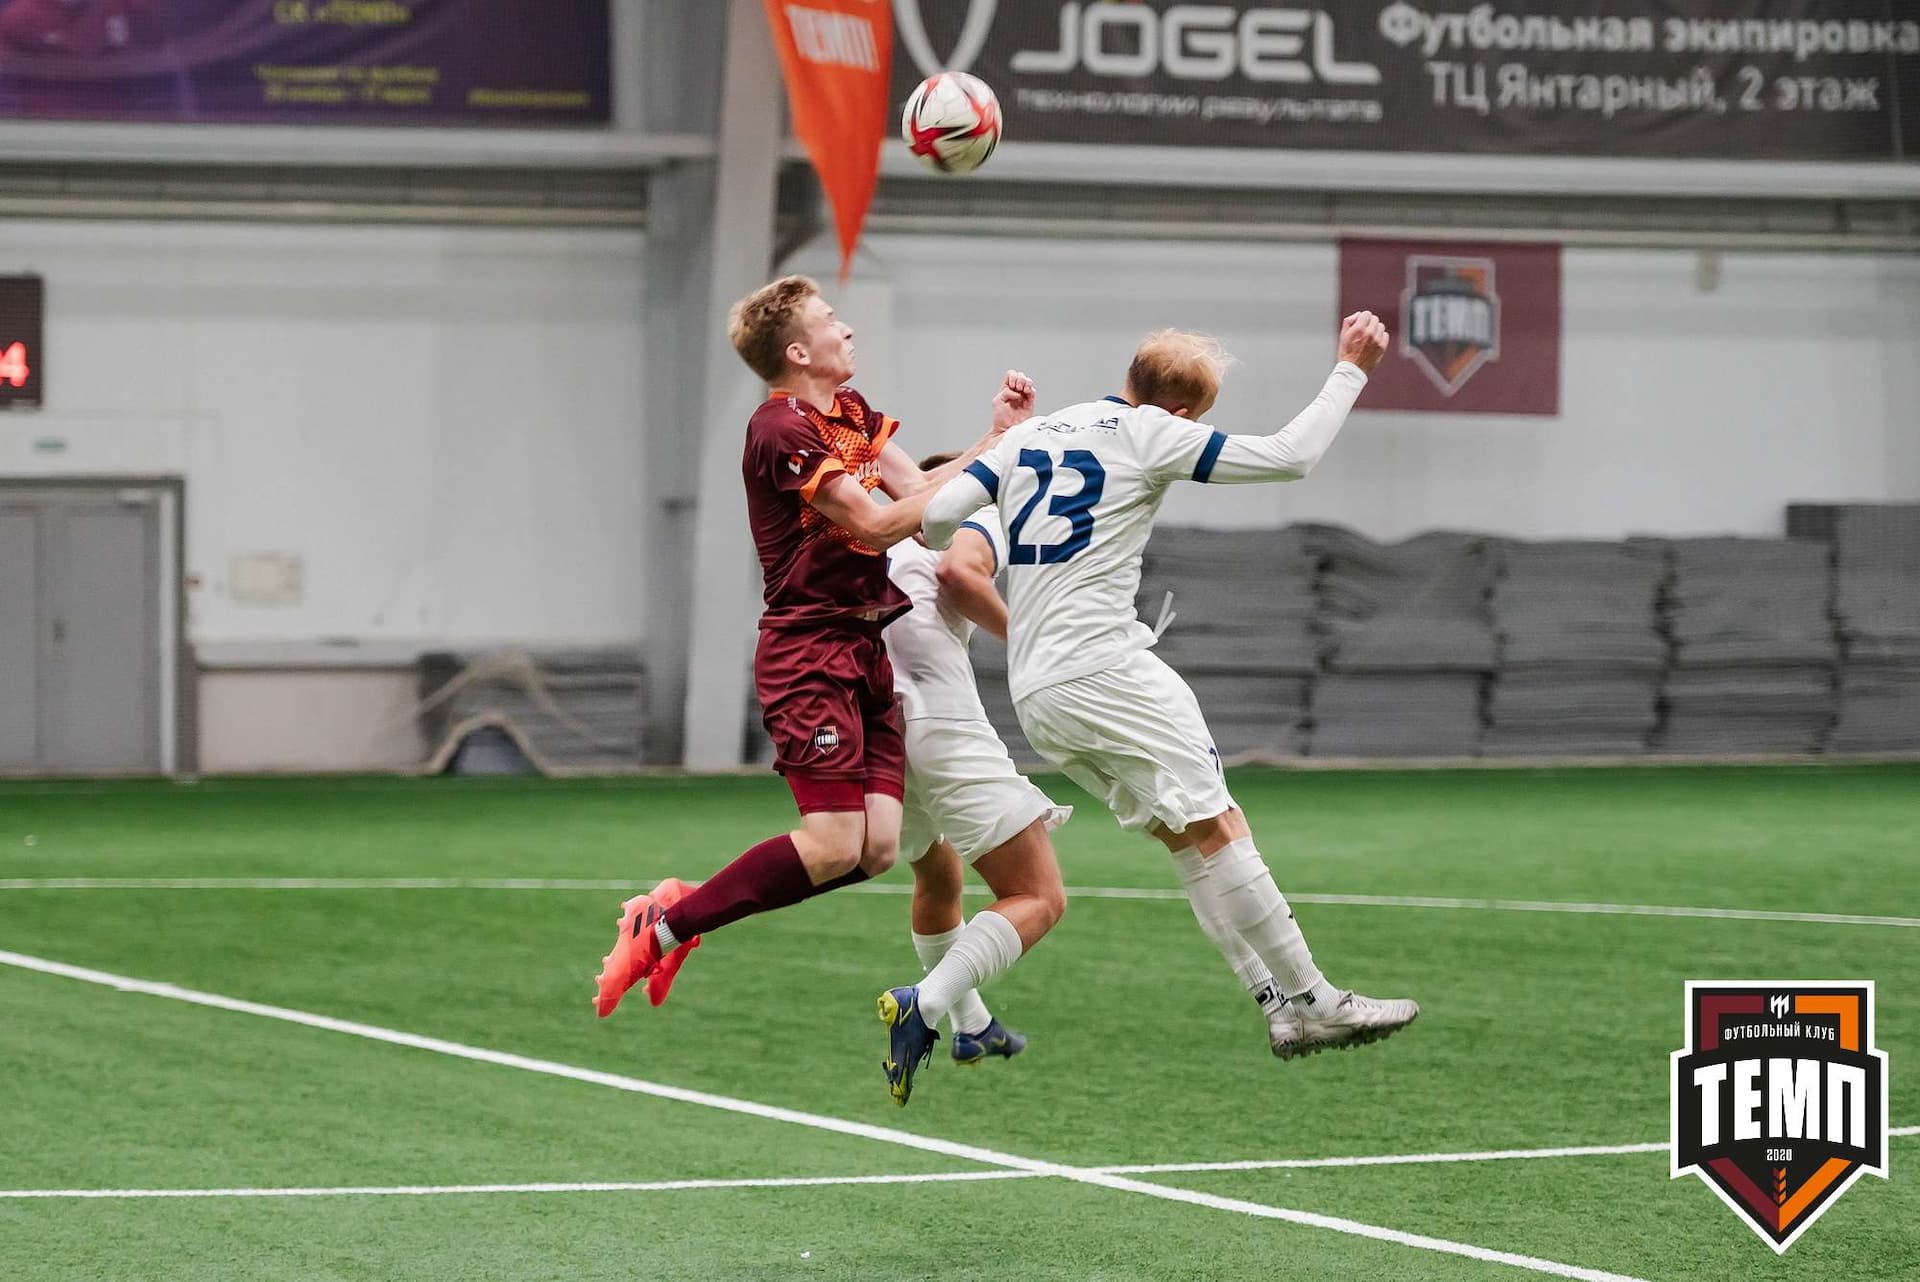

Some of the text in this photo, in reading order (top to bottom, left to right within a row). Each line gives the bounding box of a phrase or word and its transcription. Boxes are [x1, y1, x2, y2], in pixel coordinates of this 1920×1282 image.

[1379, 3, 1919, 62] Футбольная экипировка
[1424, 61, 1490, 116] ТЦ
[1736, 65, 1765, 111] 2
[1775, 76, 1882, 112] этаж
[1008, 447, 1107, 566] 23
